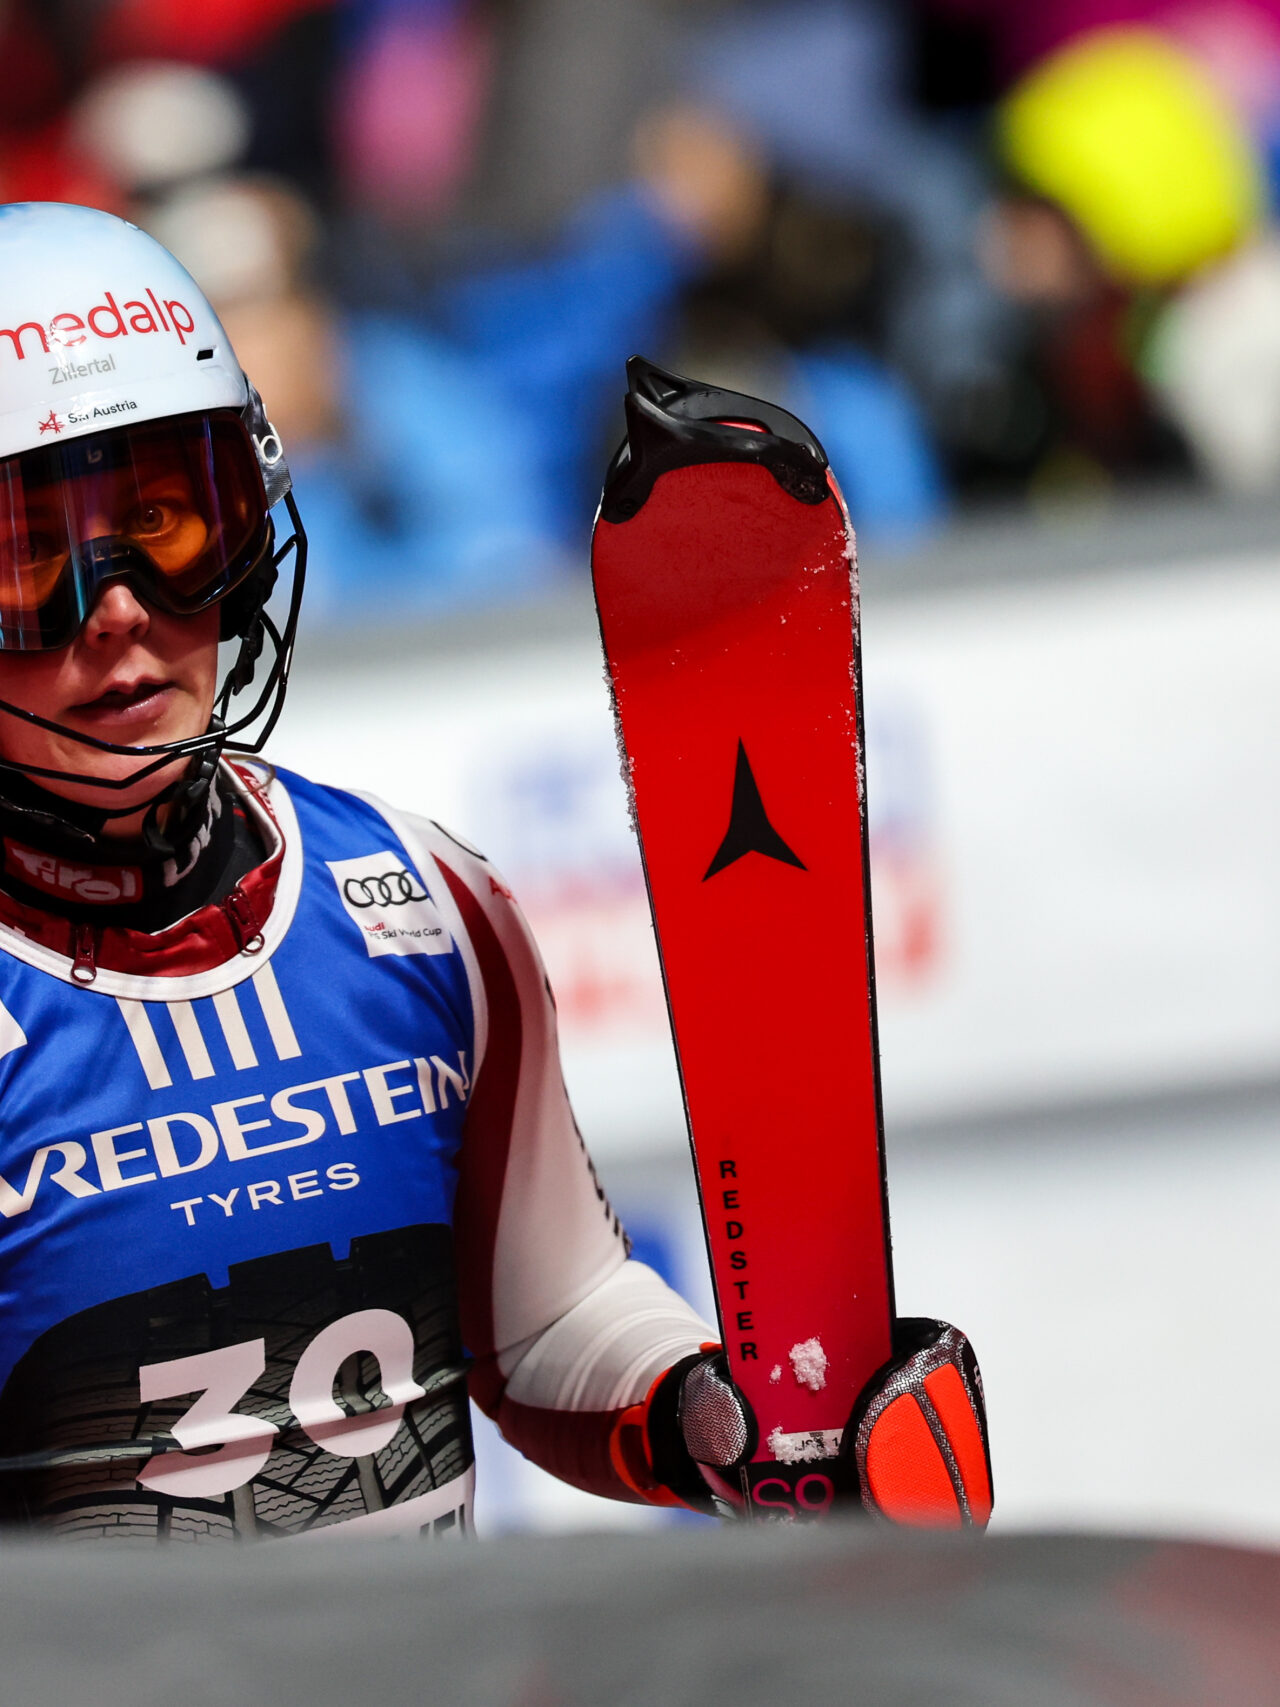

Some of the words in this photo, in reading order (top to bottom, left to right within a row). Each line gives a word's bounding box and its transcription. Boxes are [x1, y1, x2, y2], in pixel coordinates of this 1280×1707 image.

[48, 354, 116, 385] Zillertal
[93, 400, 138, 418] Austria
[423, 928, 442, 938] Cup
[170, 1162, 361, 1227] TYRES
[719, 1160, 759, 1362] REDSTER
[135, 1308, 427, 1499] 30
